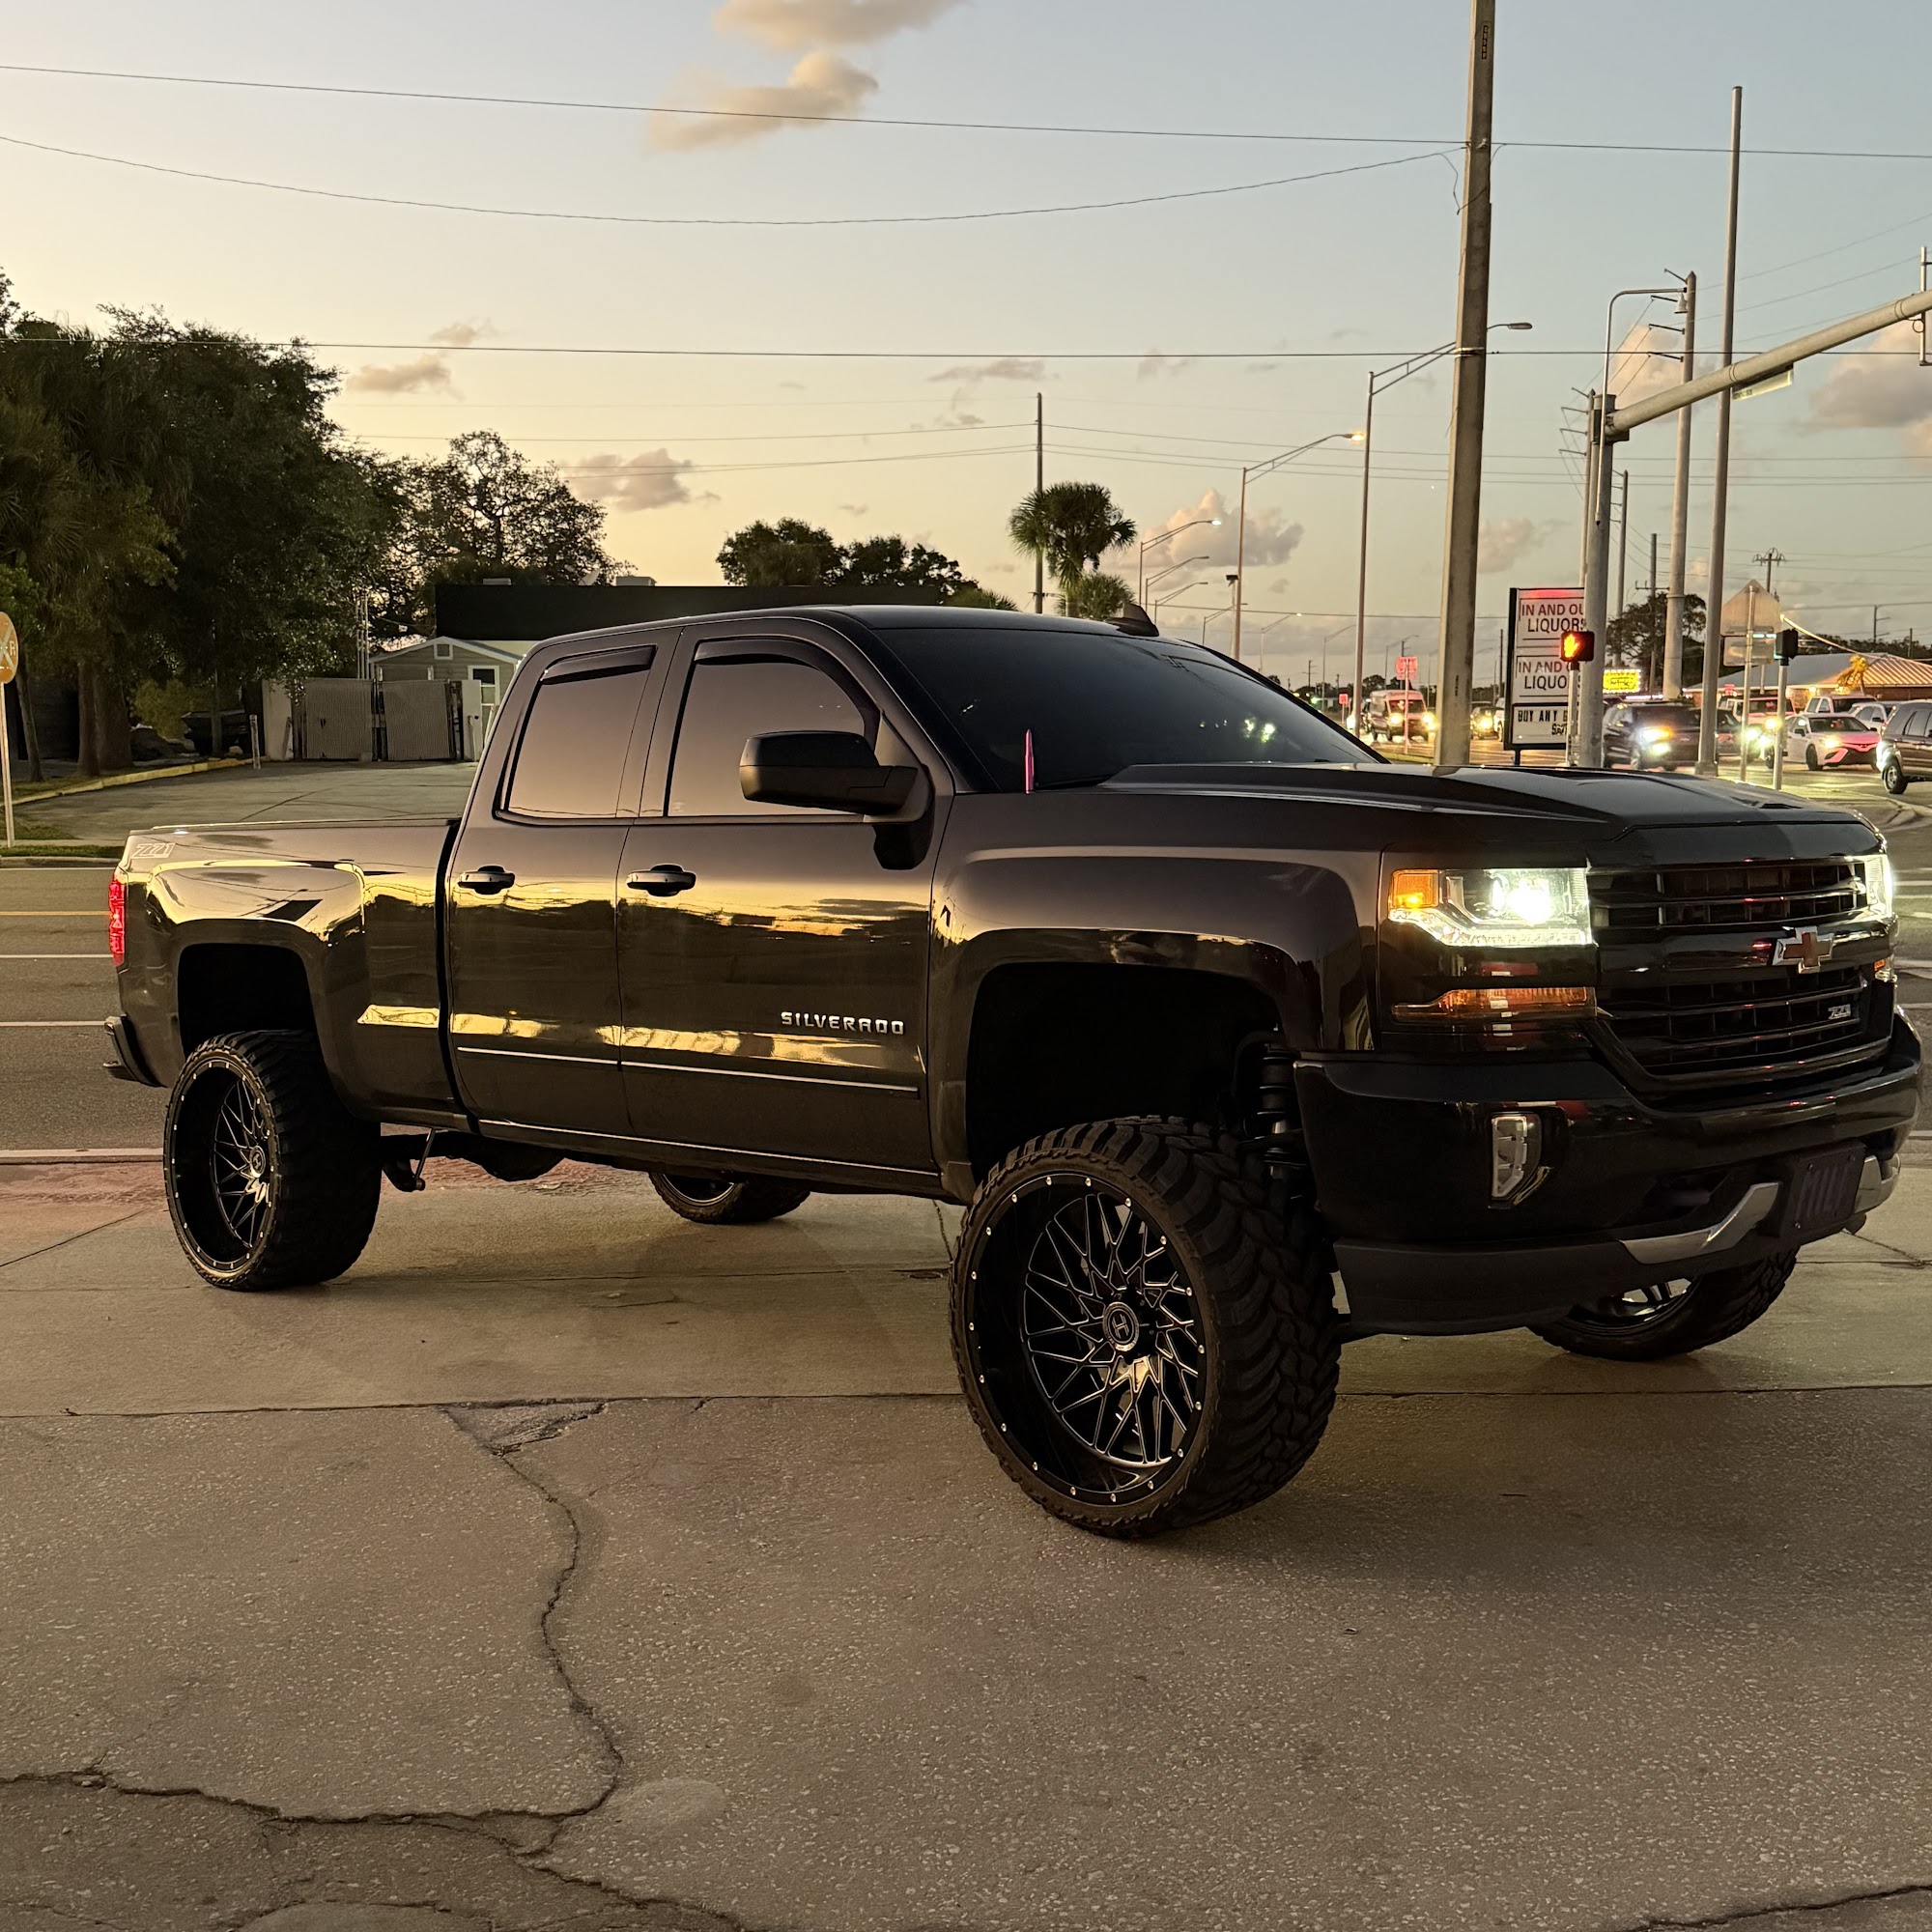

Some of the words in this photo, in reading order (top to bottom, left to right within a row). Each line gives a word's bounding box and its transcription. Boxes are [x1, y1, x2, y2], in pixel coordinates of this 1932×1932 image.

[1521, 604, 1535, 616] IN
[1538, 604, 1565, 616] AND
[1569, 604, 1584, 615] OU
[1518, 662, 1531, 673] IN
[1534, 661, 1563, 673] AND
[1524, 675, 1580, 691] LIQUO
[1518, 710, 1533, 723] BUY
[1539, 710, 1557, 723] ANY
[781, 1011, 904, 1035] SILVERADO
